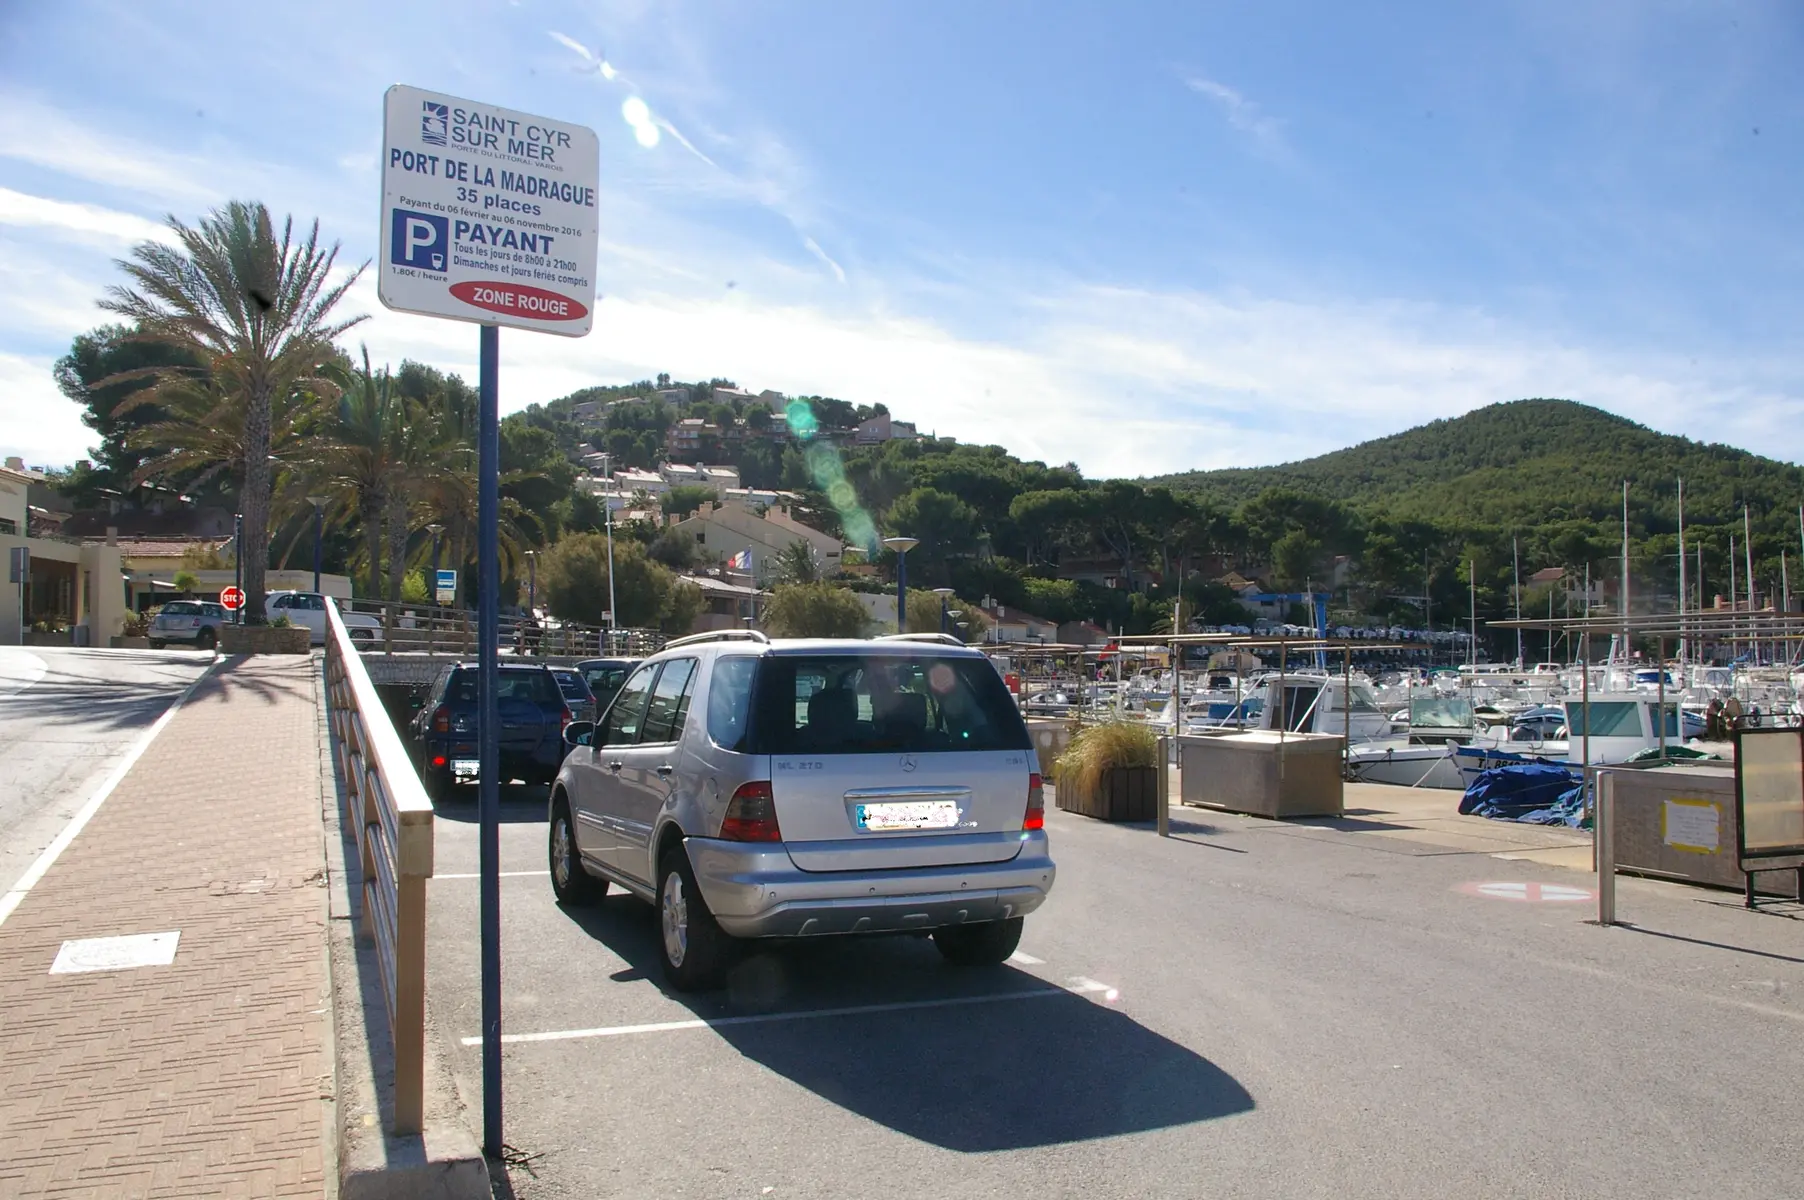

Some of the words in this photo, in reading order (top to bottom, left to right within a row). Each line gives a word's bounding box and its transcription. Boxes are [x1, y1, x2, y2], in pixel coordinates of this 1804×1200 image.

[452, 127, 498, 150] SUR
[508, 138, 556, 162] MER
[453, 108, 520, 136] SAINT
[526, 124, 571, 148] CYR
[452, 144, 479, 154] PORTE
[494, 154, 532, 165] LITTORAL
[534, 162, 563, 172] VAROIS
[391, 148, 439, 176] PORT
[446, 159, 468, 182] DE
[474, 164, 495, 186] LA
[502, 170, 594, 207] MADRAGUE
[400, 196, 431, 210] Payant
[434, 202, 445, 212] du
[447, 204, 458, 214] 06
[460, 206, 490, 220] février
[504, 215, 515, 224] 06
[516, 218, 560, 232] novembre
[561, 226, 582, 237] 2016
[457, 187, 478, 203] 35
[484, 194, 541, 216] places
[406, 217, 436, 260] P
[455, 220, 554, 255] PAYANT
[454, 242, 474, 254] Tous
[476, 246, 488, 256] les
[490, 248, 510, 260] jours
[512, 252, 522, 262] de
[524, 254, 544, 266] 8h00
[553, 259, 576, 272] 21h00
[454, 255, 500, 271] Dimanches
[501, 264, 510, 273] et
[511, 265, 532, 278] jours
[558, 274, 588, 287] compris
[392, 266, 416, 278] 1.80€
[422, 272, 448, 283] heure
[473, 287, 514, 307] ZONE
[518, 295, 568, 316] ROUGE
